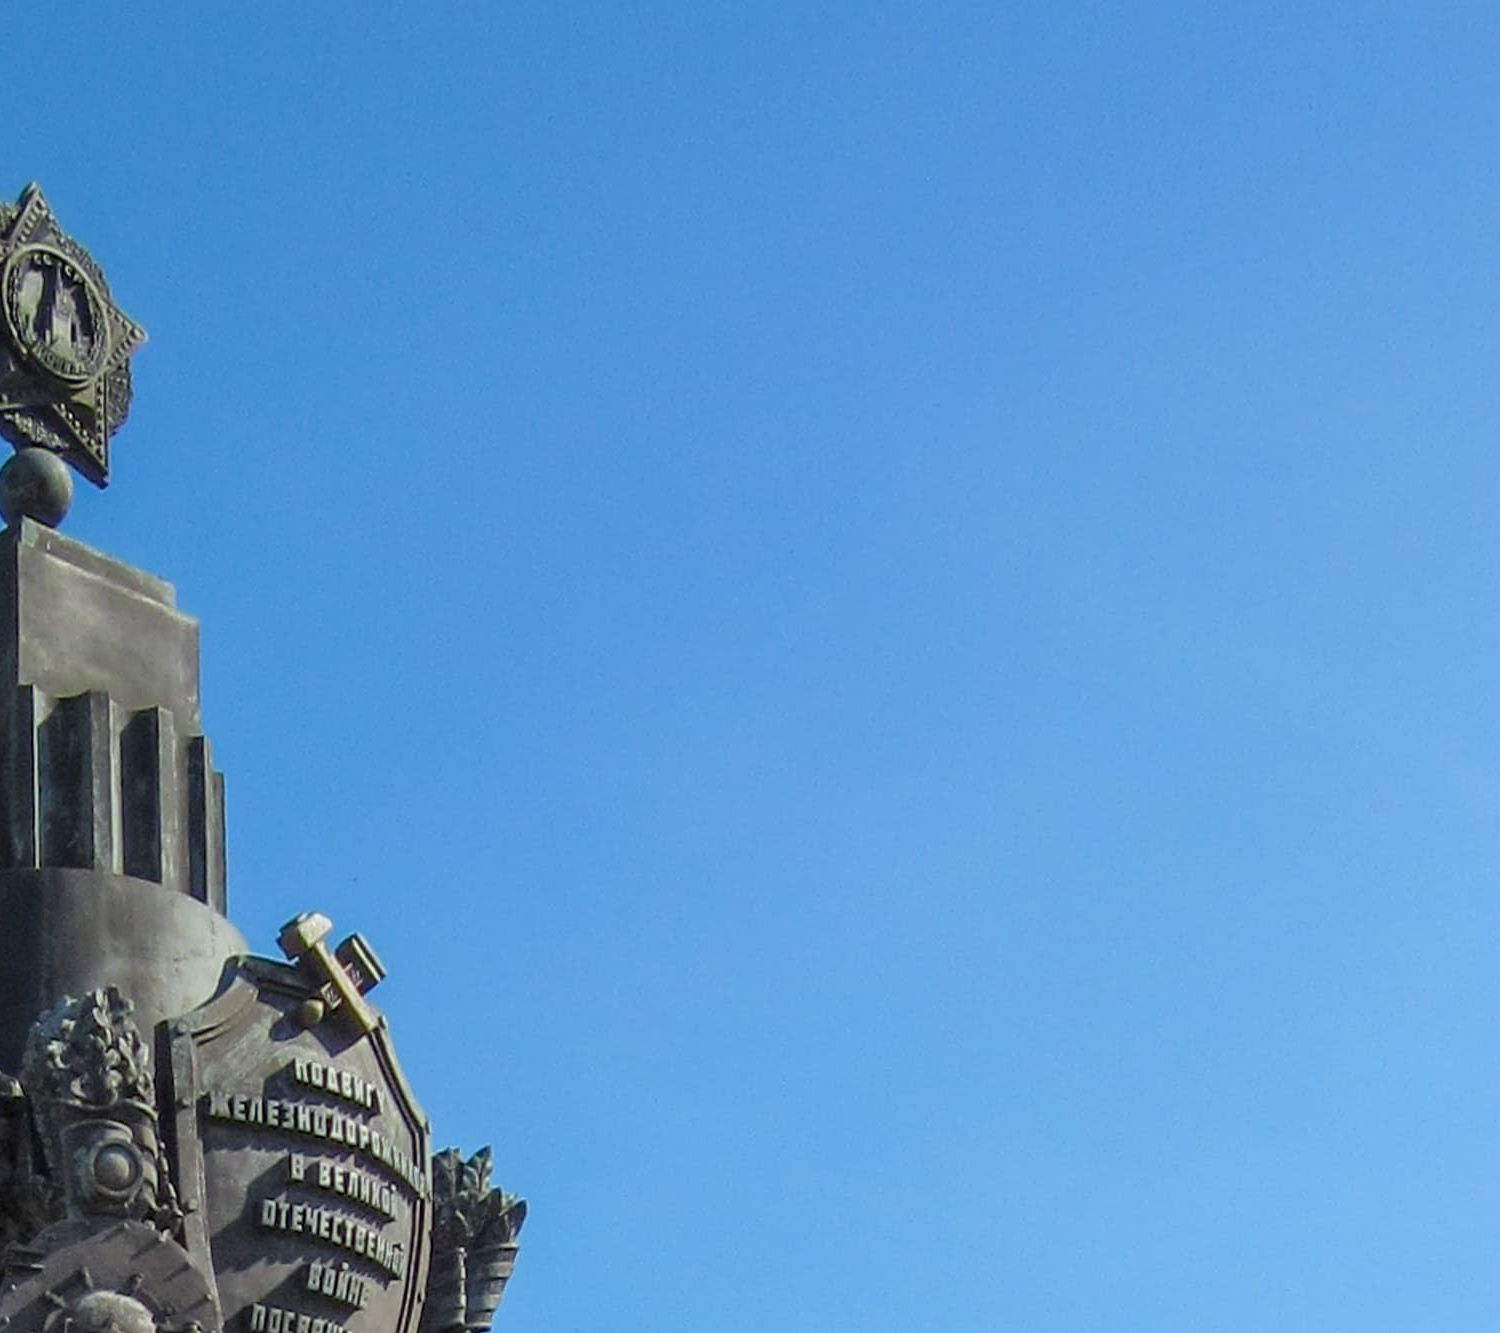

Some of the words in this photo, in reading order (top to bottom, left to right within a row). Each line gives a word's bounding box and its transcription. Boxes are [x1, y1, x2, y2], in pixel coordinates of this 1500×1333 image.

[295, 1057, 385, 1113] ПОДВИГУ
[291, 1153, 304, 1180] В
[319, 1161, 401, 1219] ВЕЛИКОЙ
[307, 1262, 369, 1308] ВОЙНЕ
